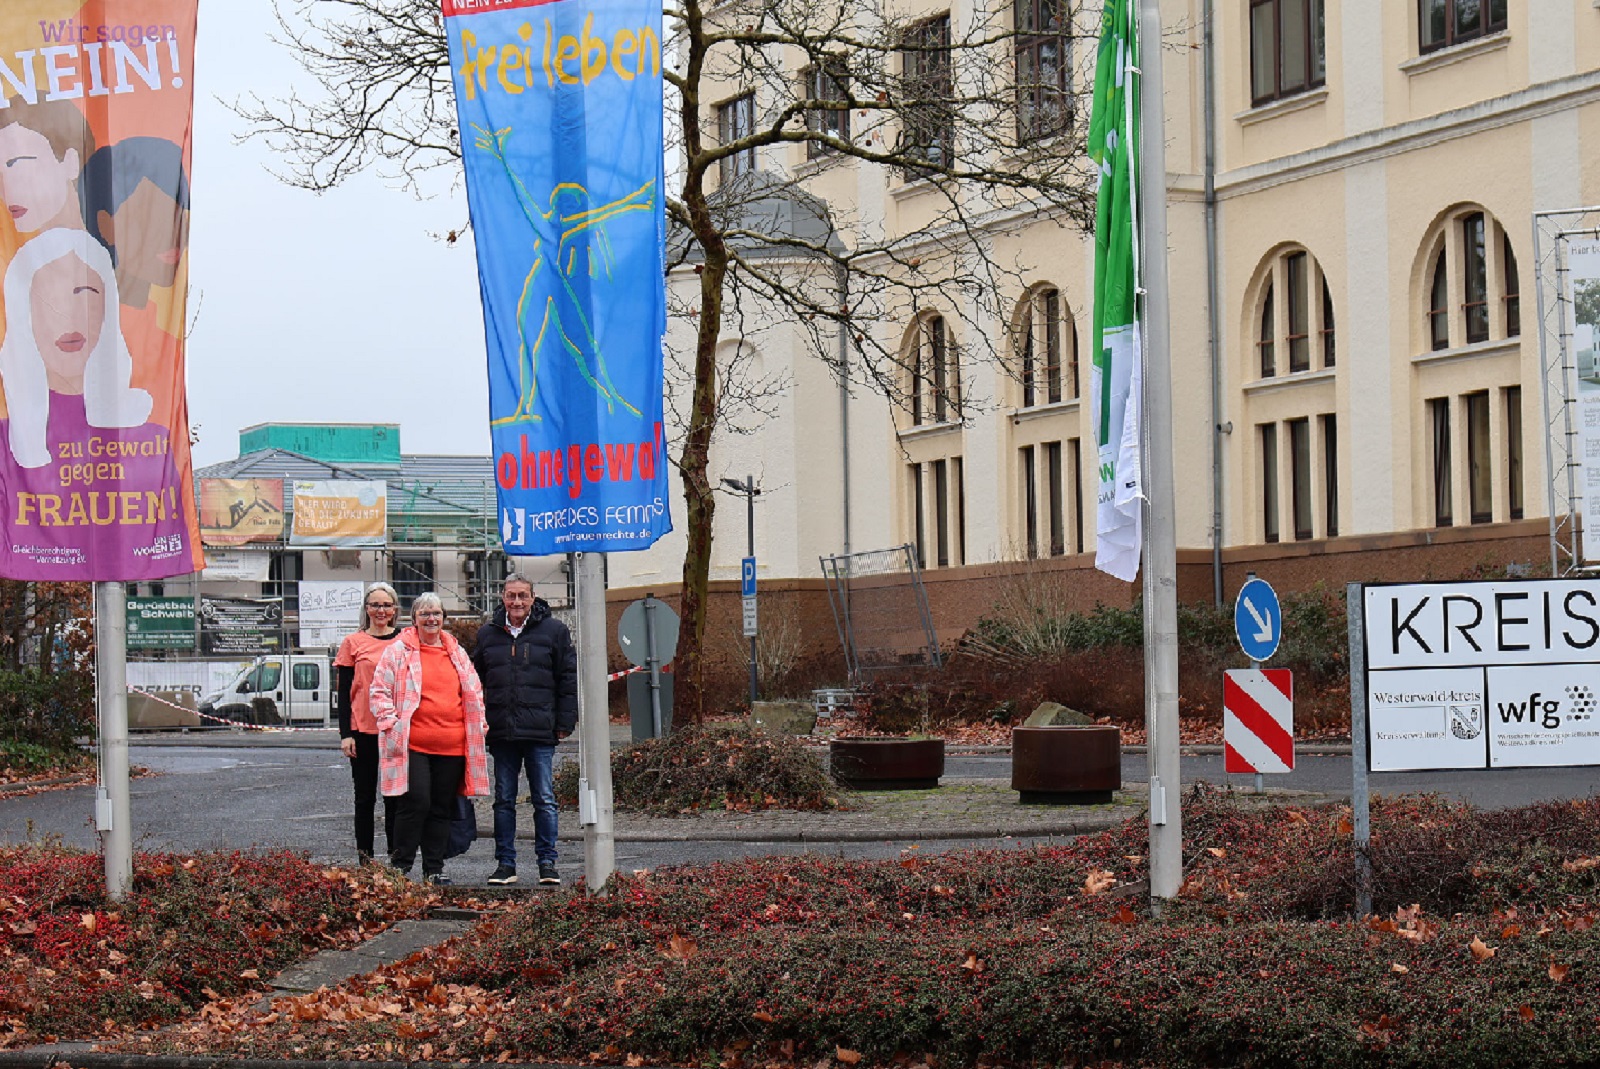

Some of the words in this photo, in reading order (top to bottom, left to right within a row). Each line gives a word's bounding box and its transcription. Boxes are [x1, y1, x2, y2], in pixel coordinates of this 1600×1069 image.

[39, 19, 89, 43] Wir
[96, 25, 177, 48] sagen
[0, 31, 184, 109] NEIN!
[58, 441, 83, 458] zu
[87, 434, 170, 457] Gewalt
[59, 462, 126, 486] gegen
[14, 486, 179, 526] FRAUEN!
[568, 507, 600, 527] DES
[154, 536, 167, 545] UN
[744, 562, 754, 592] P
[1391, 590, 1600, 655] KREIS
[1498, 693, 1560, 729] wfg
